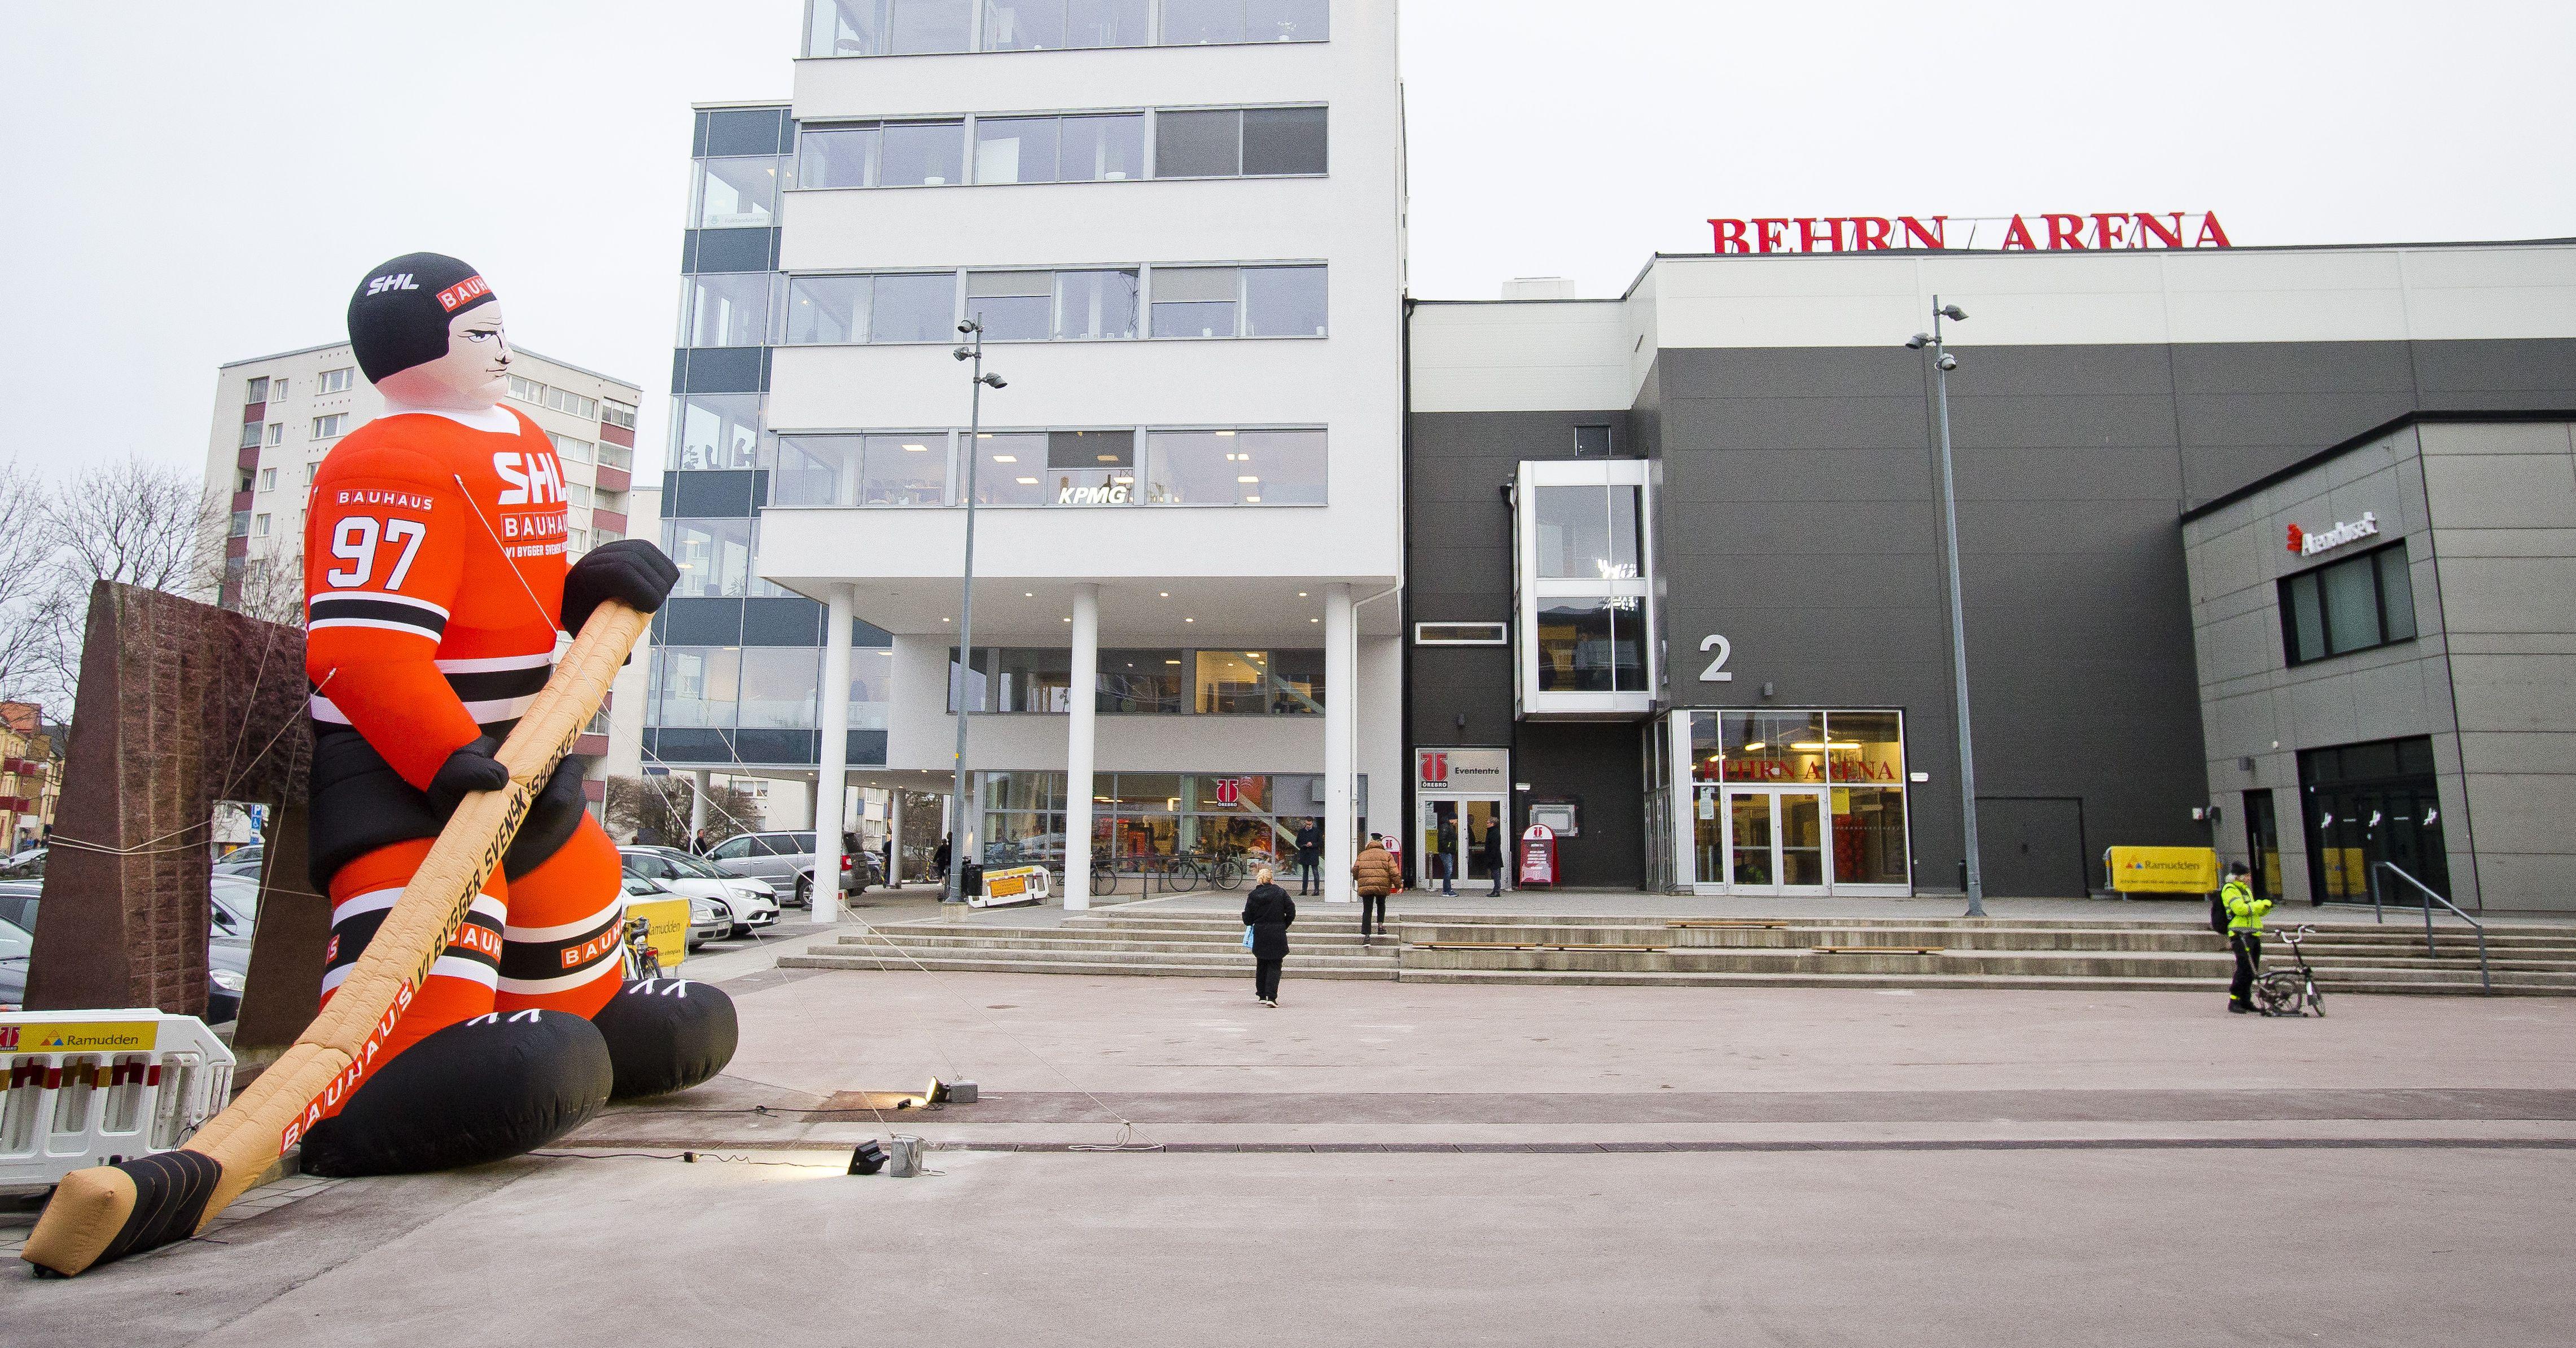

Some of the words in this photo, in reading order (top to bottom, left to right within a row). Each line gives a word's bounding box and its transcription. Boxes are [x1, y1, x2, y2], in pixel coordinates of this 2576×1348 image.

[1707, 216, 1948, 254] BEHRN
[2001, 210, 2232, 251] ARENA
[366, 273, 419, 296] SHL
[493, 452, 567, 505] SHL
[339, 491, 432, 510] BAUHAUS
[1058, 486, 1127, 504] KPMG
[327, 516, 427, 591] 97
[506, 546, 515, 557] VI
[517, 545, 544, 557] BYGGER
[1699, 635, 1732, 682] 2
[1704, 760, 1796, 780] BEHRN
[1803, 761, 1895, 780] ARENA
[2145, 860, 2200, 870] Ramudden
[418, 952, 430, 981] VI
[434, 868, 481, 958] BYGGER
[485, 787, 527, 876] SVENSK
[67, 1034, 138, 1046] Ramudden
[283, 985, 413, 1152] BAUHAUS
